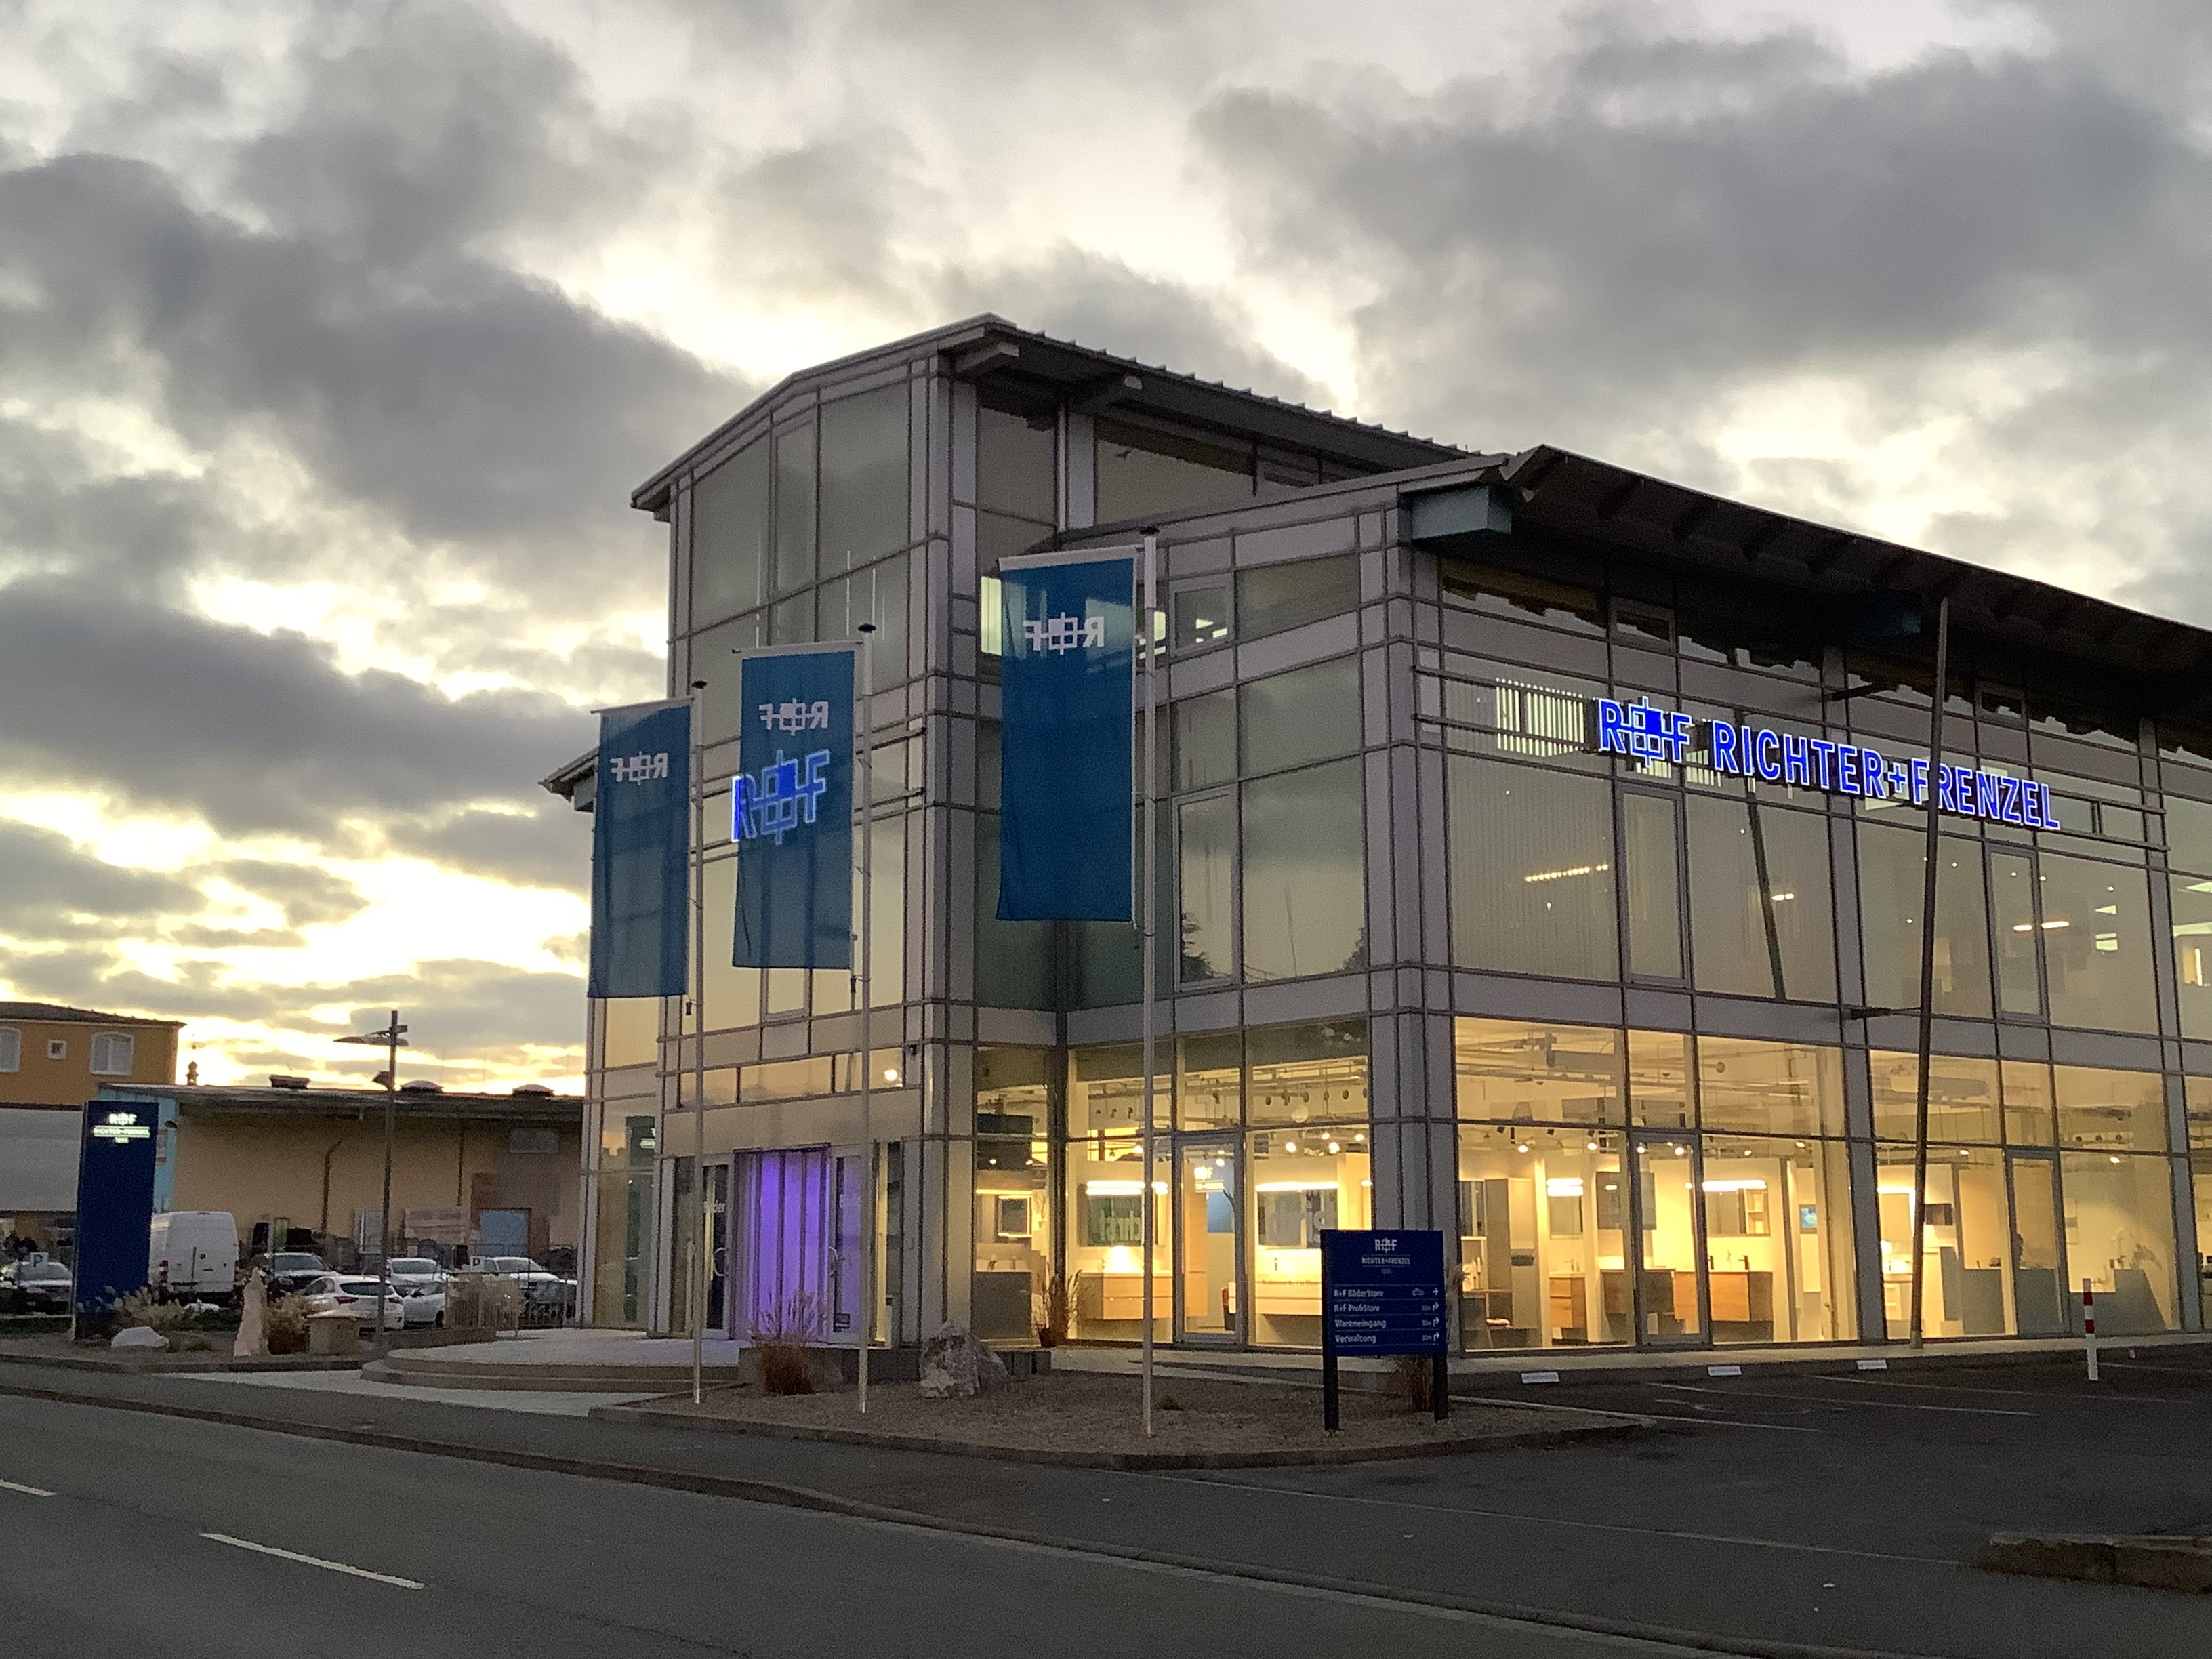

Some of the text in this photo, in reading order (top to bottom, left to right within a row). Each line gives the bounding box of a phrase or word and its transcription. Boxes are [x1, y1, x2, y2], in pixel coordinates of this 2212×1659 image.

[1712, 719, 2061, 831] RICHTER+FRENZEL
[1334, 1289, 1347, 1298] R+F
[1334, 1303, 1347, 1313] R+F
[1335, 1334, 1377, 1344] Verwaltung
